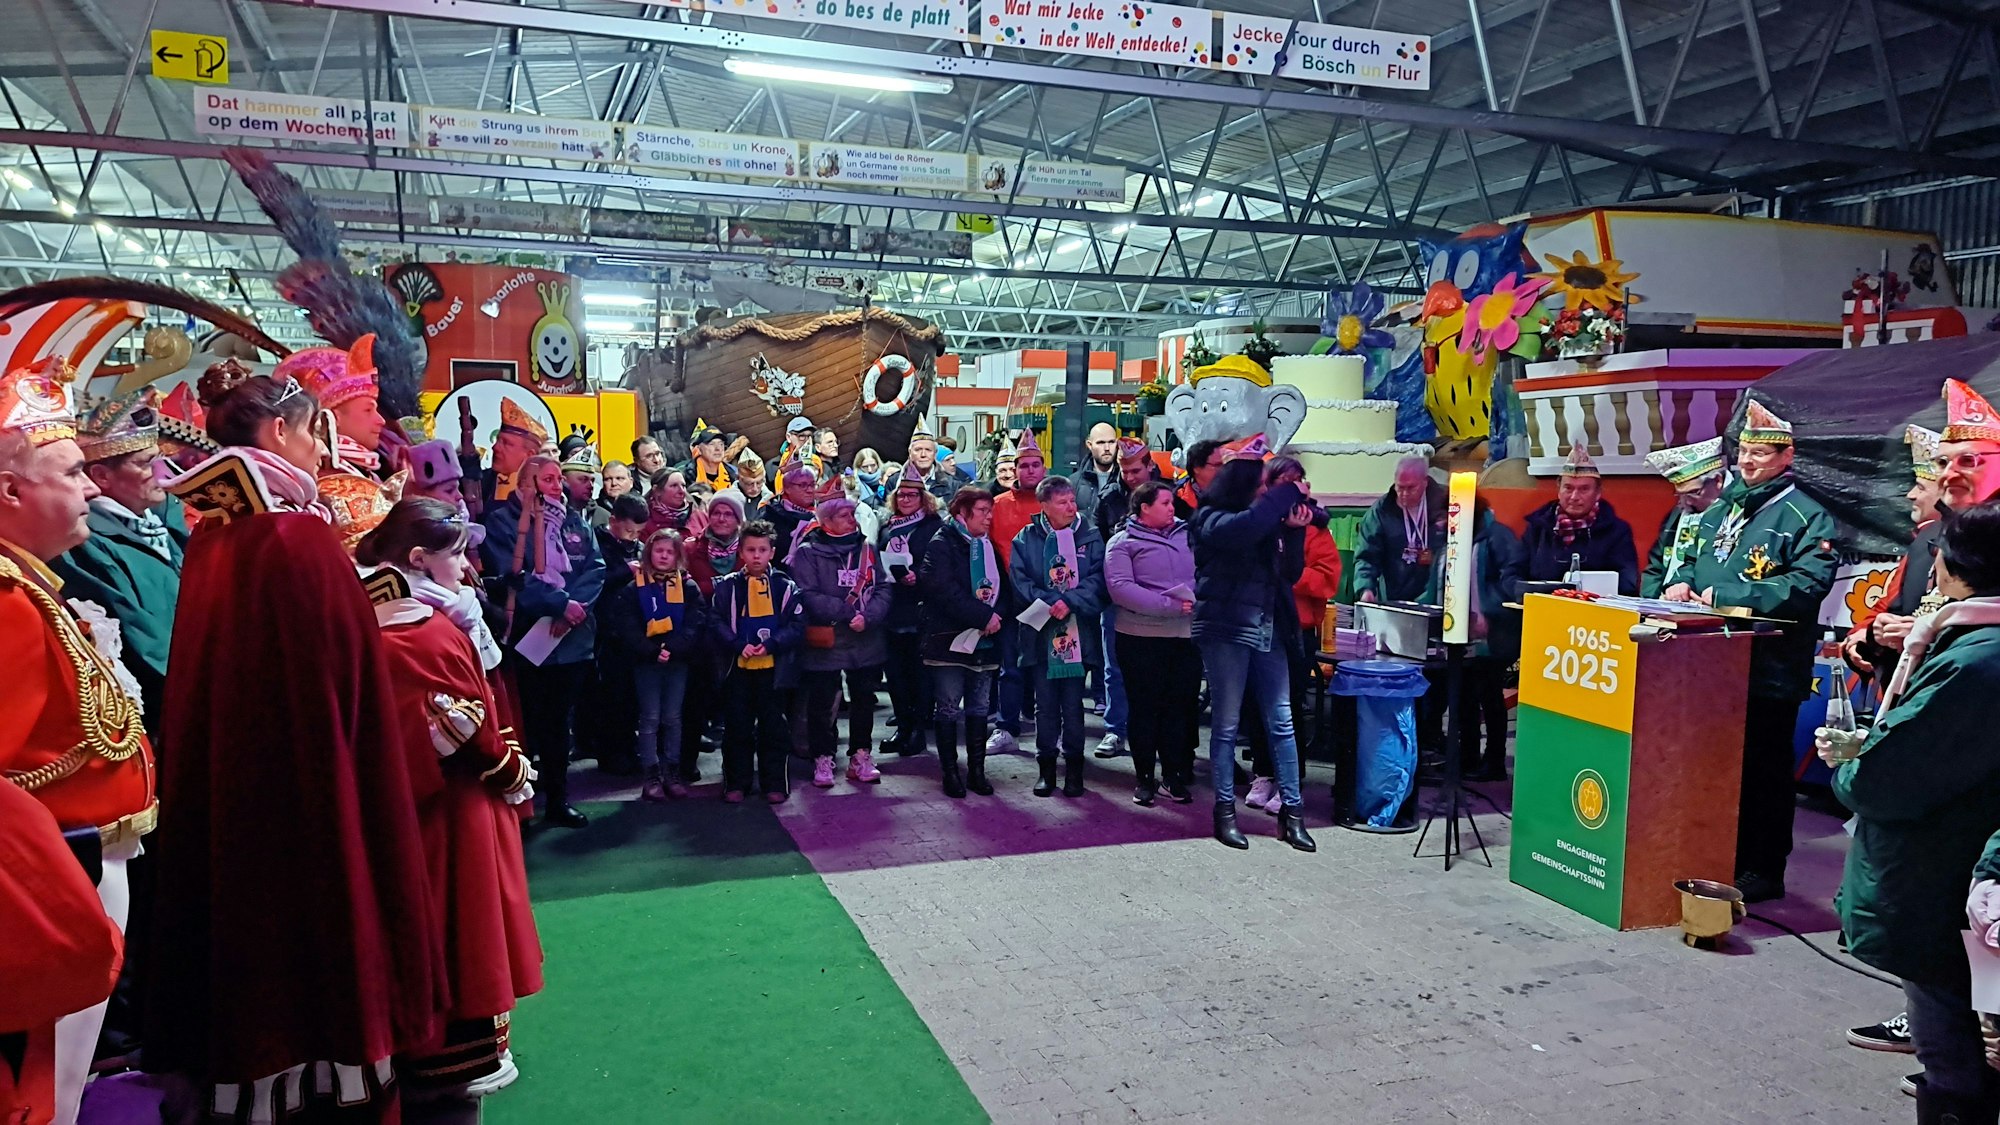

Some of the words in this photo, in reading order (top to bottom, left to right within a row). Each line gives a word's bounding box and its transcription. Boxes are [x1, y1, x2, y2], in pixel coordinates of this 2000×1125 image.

[816, 0, 836, 15] do
[845, 0, 875, 19] bes
[883, 2, 904, 22] de
[911, 5, 951, 28] platt
[1004, 0, 1032, 16] Wat
[1038, 2, 1062, 18] mir
[1067, 3, 1104, 20] Jecke
[1040, 28, 1051, 46] in
[1057, 30, 1080, 48] der
[1086, 32, 1116, 50] Welt
[1121, 36, 1187, 54] entdecke!
[1233, 24, 1283, 43] Jecke
[1292, 30, 1327, 49] Tour
[1332, 35, 1380, 55] durch
[1303, 55, 1355, 75] Bösch
[1361, 64, 1381, 77] un
[1387, 64, 1421, 81] Flur
[208, 95, 239, 110] Dat
[245, 98, 319, 117] hammer
[326, 105, 345, 118] all
[209, 116, 231, 130] op
[240, 116, 278, 131] dem
[430, 114, 455, 126] Kütt
[459, 119, 477, 128] die
[482, 119, 522, 134] Strung
[527, 125, 541, 134] us
[545, 125, 578, 137] ihrem
[582, 127, 606, 138] Bett
[454, 135, 468, 143] se
[472, 134, 490, 145] vill
[494, 138, 508, 146] zo
[636, 131, 694, 148] Stärnche,
[733, 142, 747, 152] un
[751, 142, 790, 156] Krone,
[651, 150, 704, 165] Gläbbich
[708, 157, 722, 166] es
[725, 157, 740, 168] nit
[744, 159, 777, 171] ohne!
[846, 149, 862, 158] Wie
[864, 151, 877, 160] ald
[879, 153, 892, 161] bei
[907, 154, 934, 163] Römer
[846, 171, 868, 179] noch
[869, 173, 898, 181] emmer
[860, 161, 898, 171] Germane
[929, 167, 951, 175] Stadt
[1027, 164, 1037, 172] de
[1080, 168, 1092, 177] Tal
[1067, 179, 1103, 188] zesamme
[1077, 188, 1120, 198] KARNEVAL
[474, 203, 495, 214] Ene
[484, 272, 535, 306] harlotte
[426, 296, 463, 337] Bauer
[1543, 645, 1618, 694] 2025
[1557, 839, 1607, 866] ENGAGEMENT
[1532, 852, 1605, 890] GEMEINSCHAFTSSINN
[1589, 864, 1606, 878] UND
